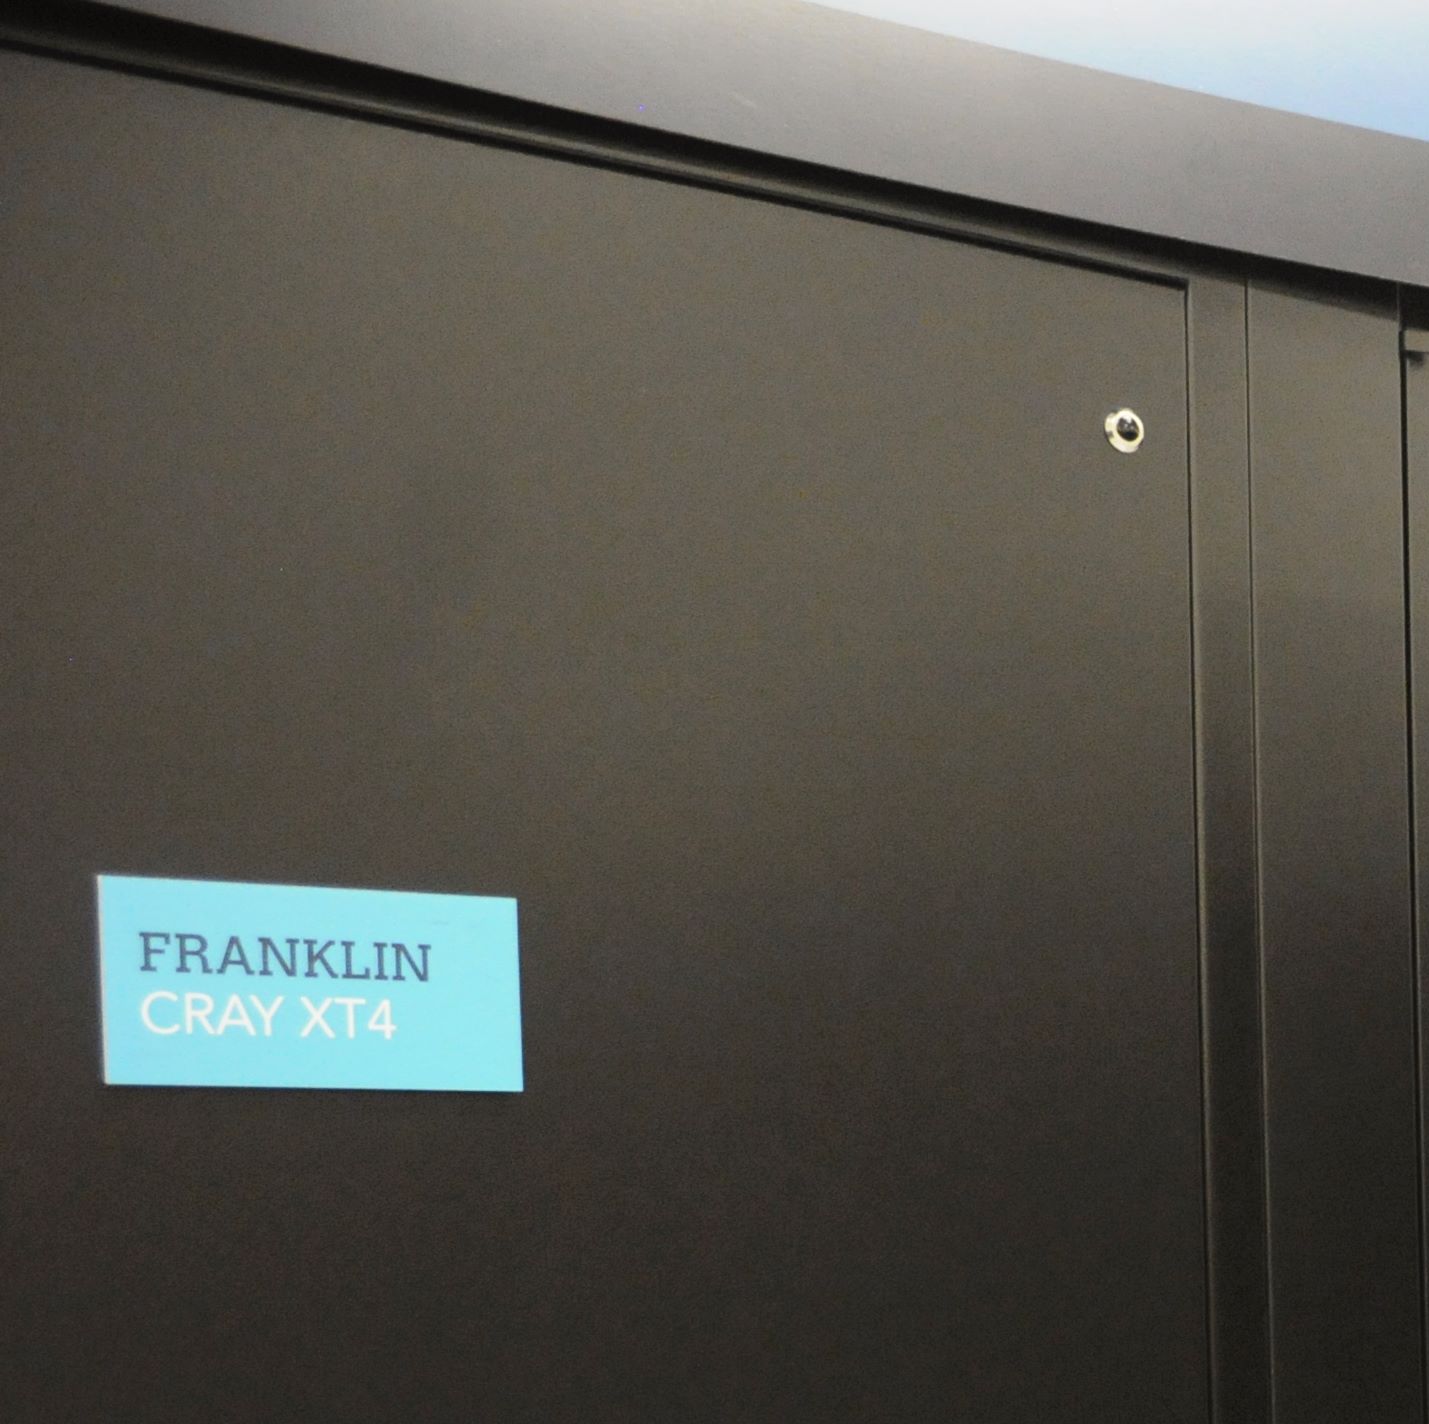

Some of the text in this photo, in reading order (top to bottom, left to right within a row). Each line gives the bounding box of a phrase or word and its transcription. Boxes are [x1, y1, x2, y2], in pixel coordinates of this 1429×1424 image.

[137, 931, 432, 983] FRANKLIN
[139, 990, 398, 1040] CRAY XT4
